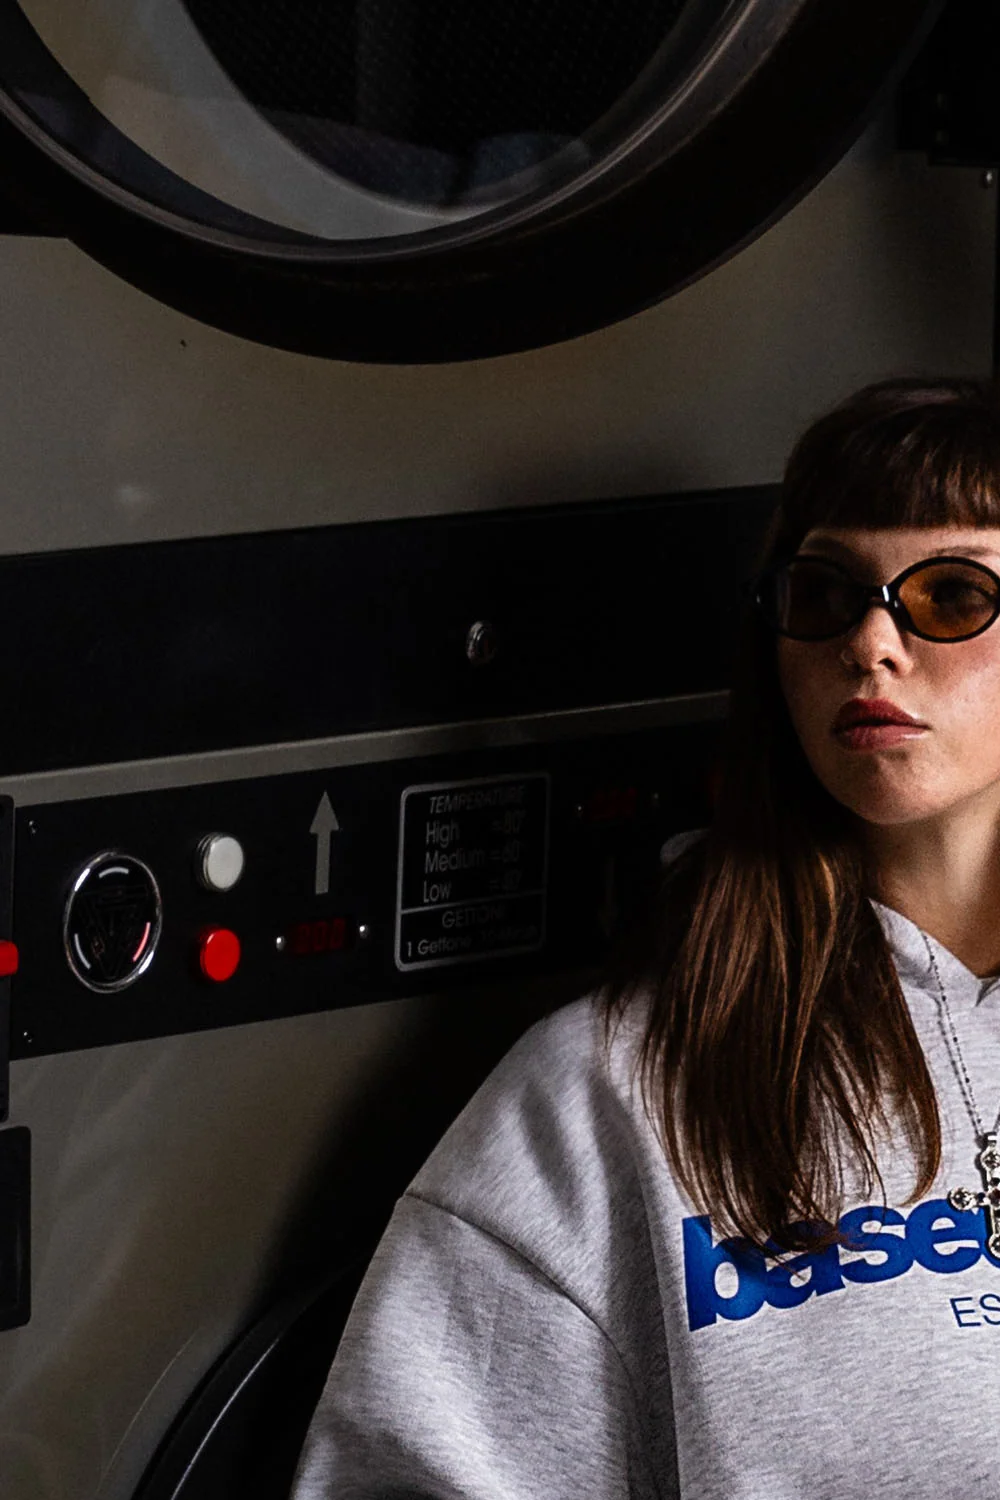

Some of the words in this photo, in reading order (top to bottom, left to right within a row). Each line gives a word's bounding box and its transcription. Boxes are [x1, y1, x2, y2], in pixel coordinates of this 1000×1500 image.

[425, 819, 460, 849] High
[424, 848, 485, 875] Medium
[423, 879, 452, 903] Low
